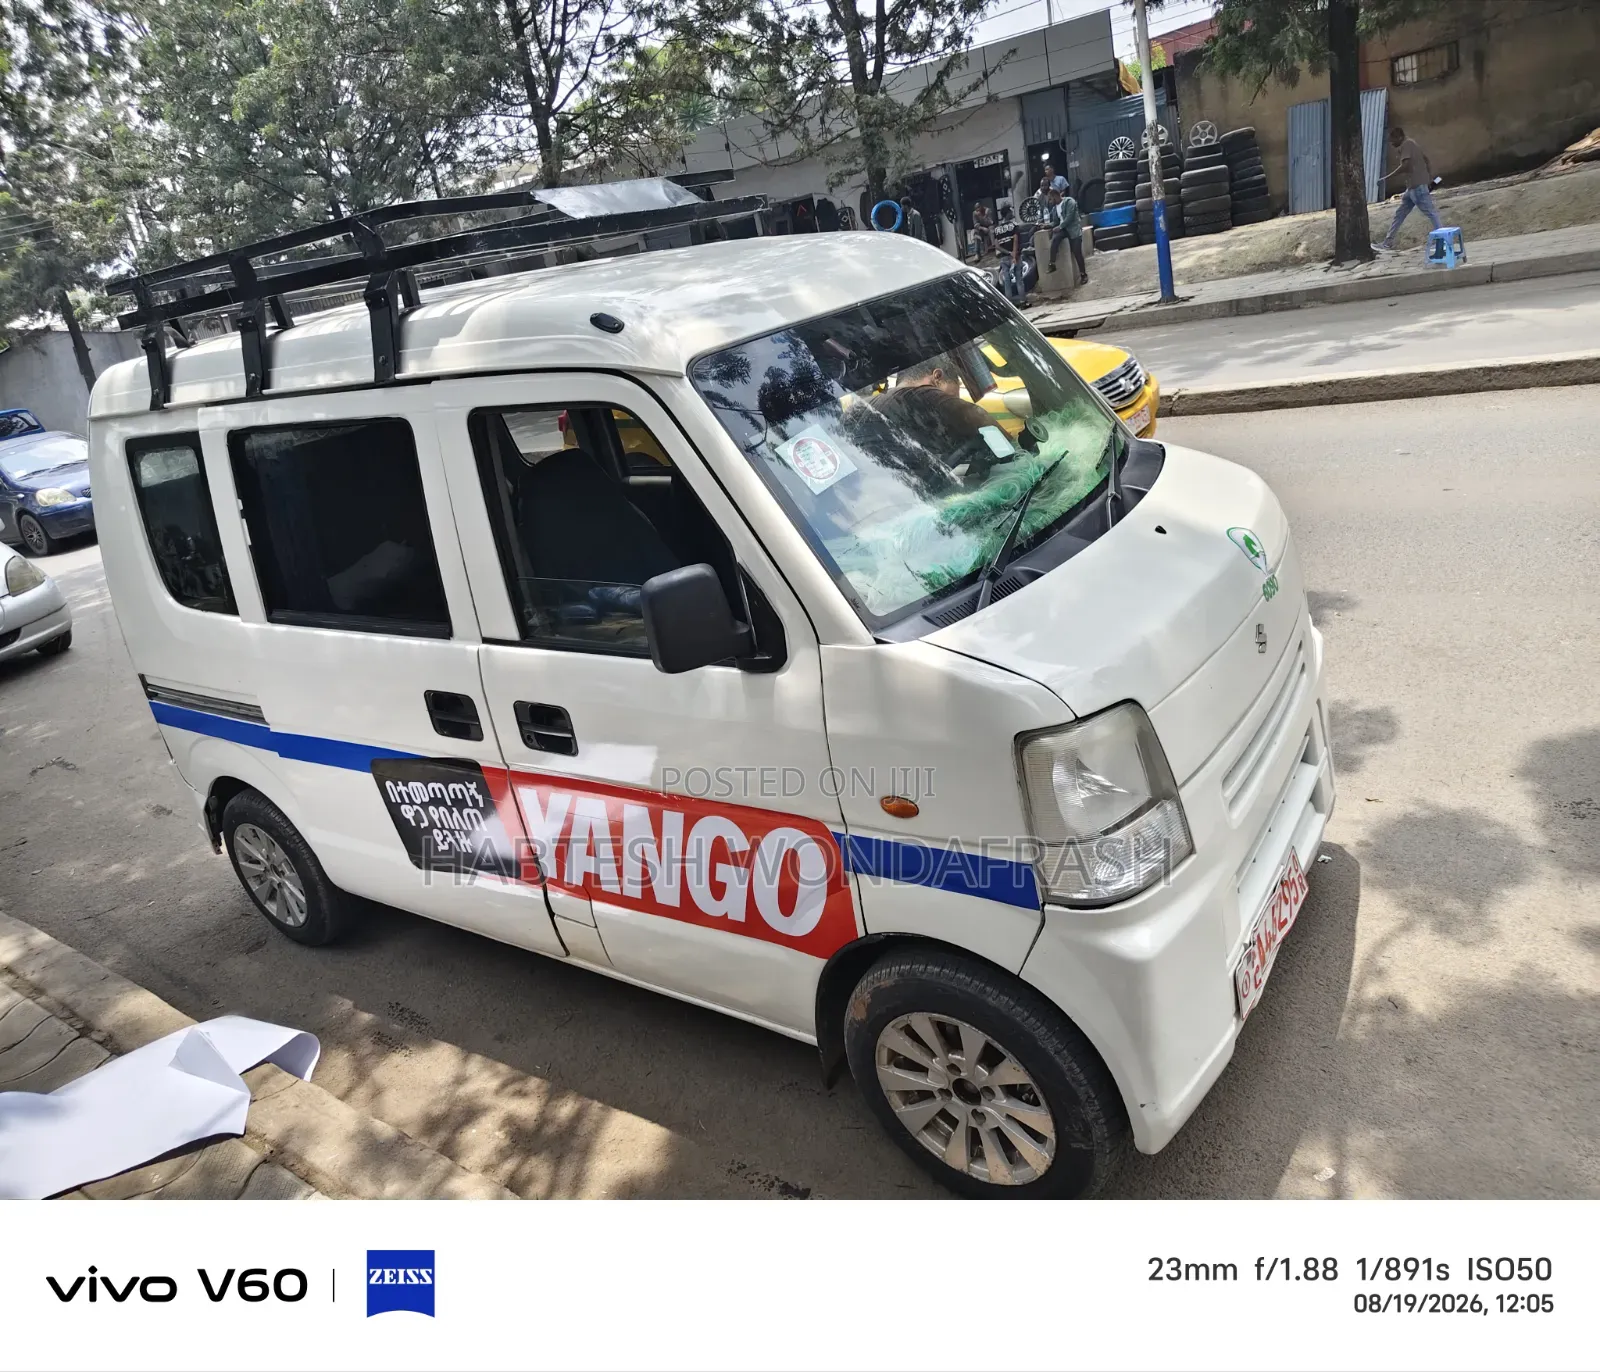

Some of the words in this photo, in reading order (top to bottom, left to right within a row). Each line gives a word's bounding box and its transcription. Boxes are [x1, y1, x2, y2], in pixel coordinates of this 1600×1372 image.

[385, 780, 484, 808] በተመጣጣኝ
[400, 804, 429, 828] ዋጋ
[428, 805, 488, 832] የበለጠ
[518, 787, 827, 937] YANGO
